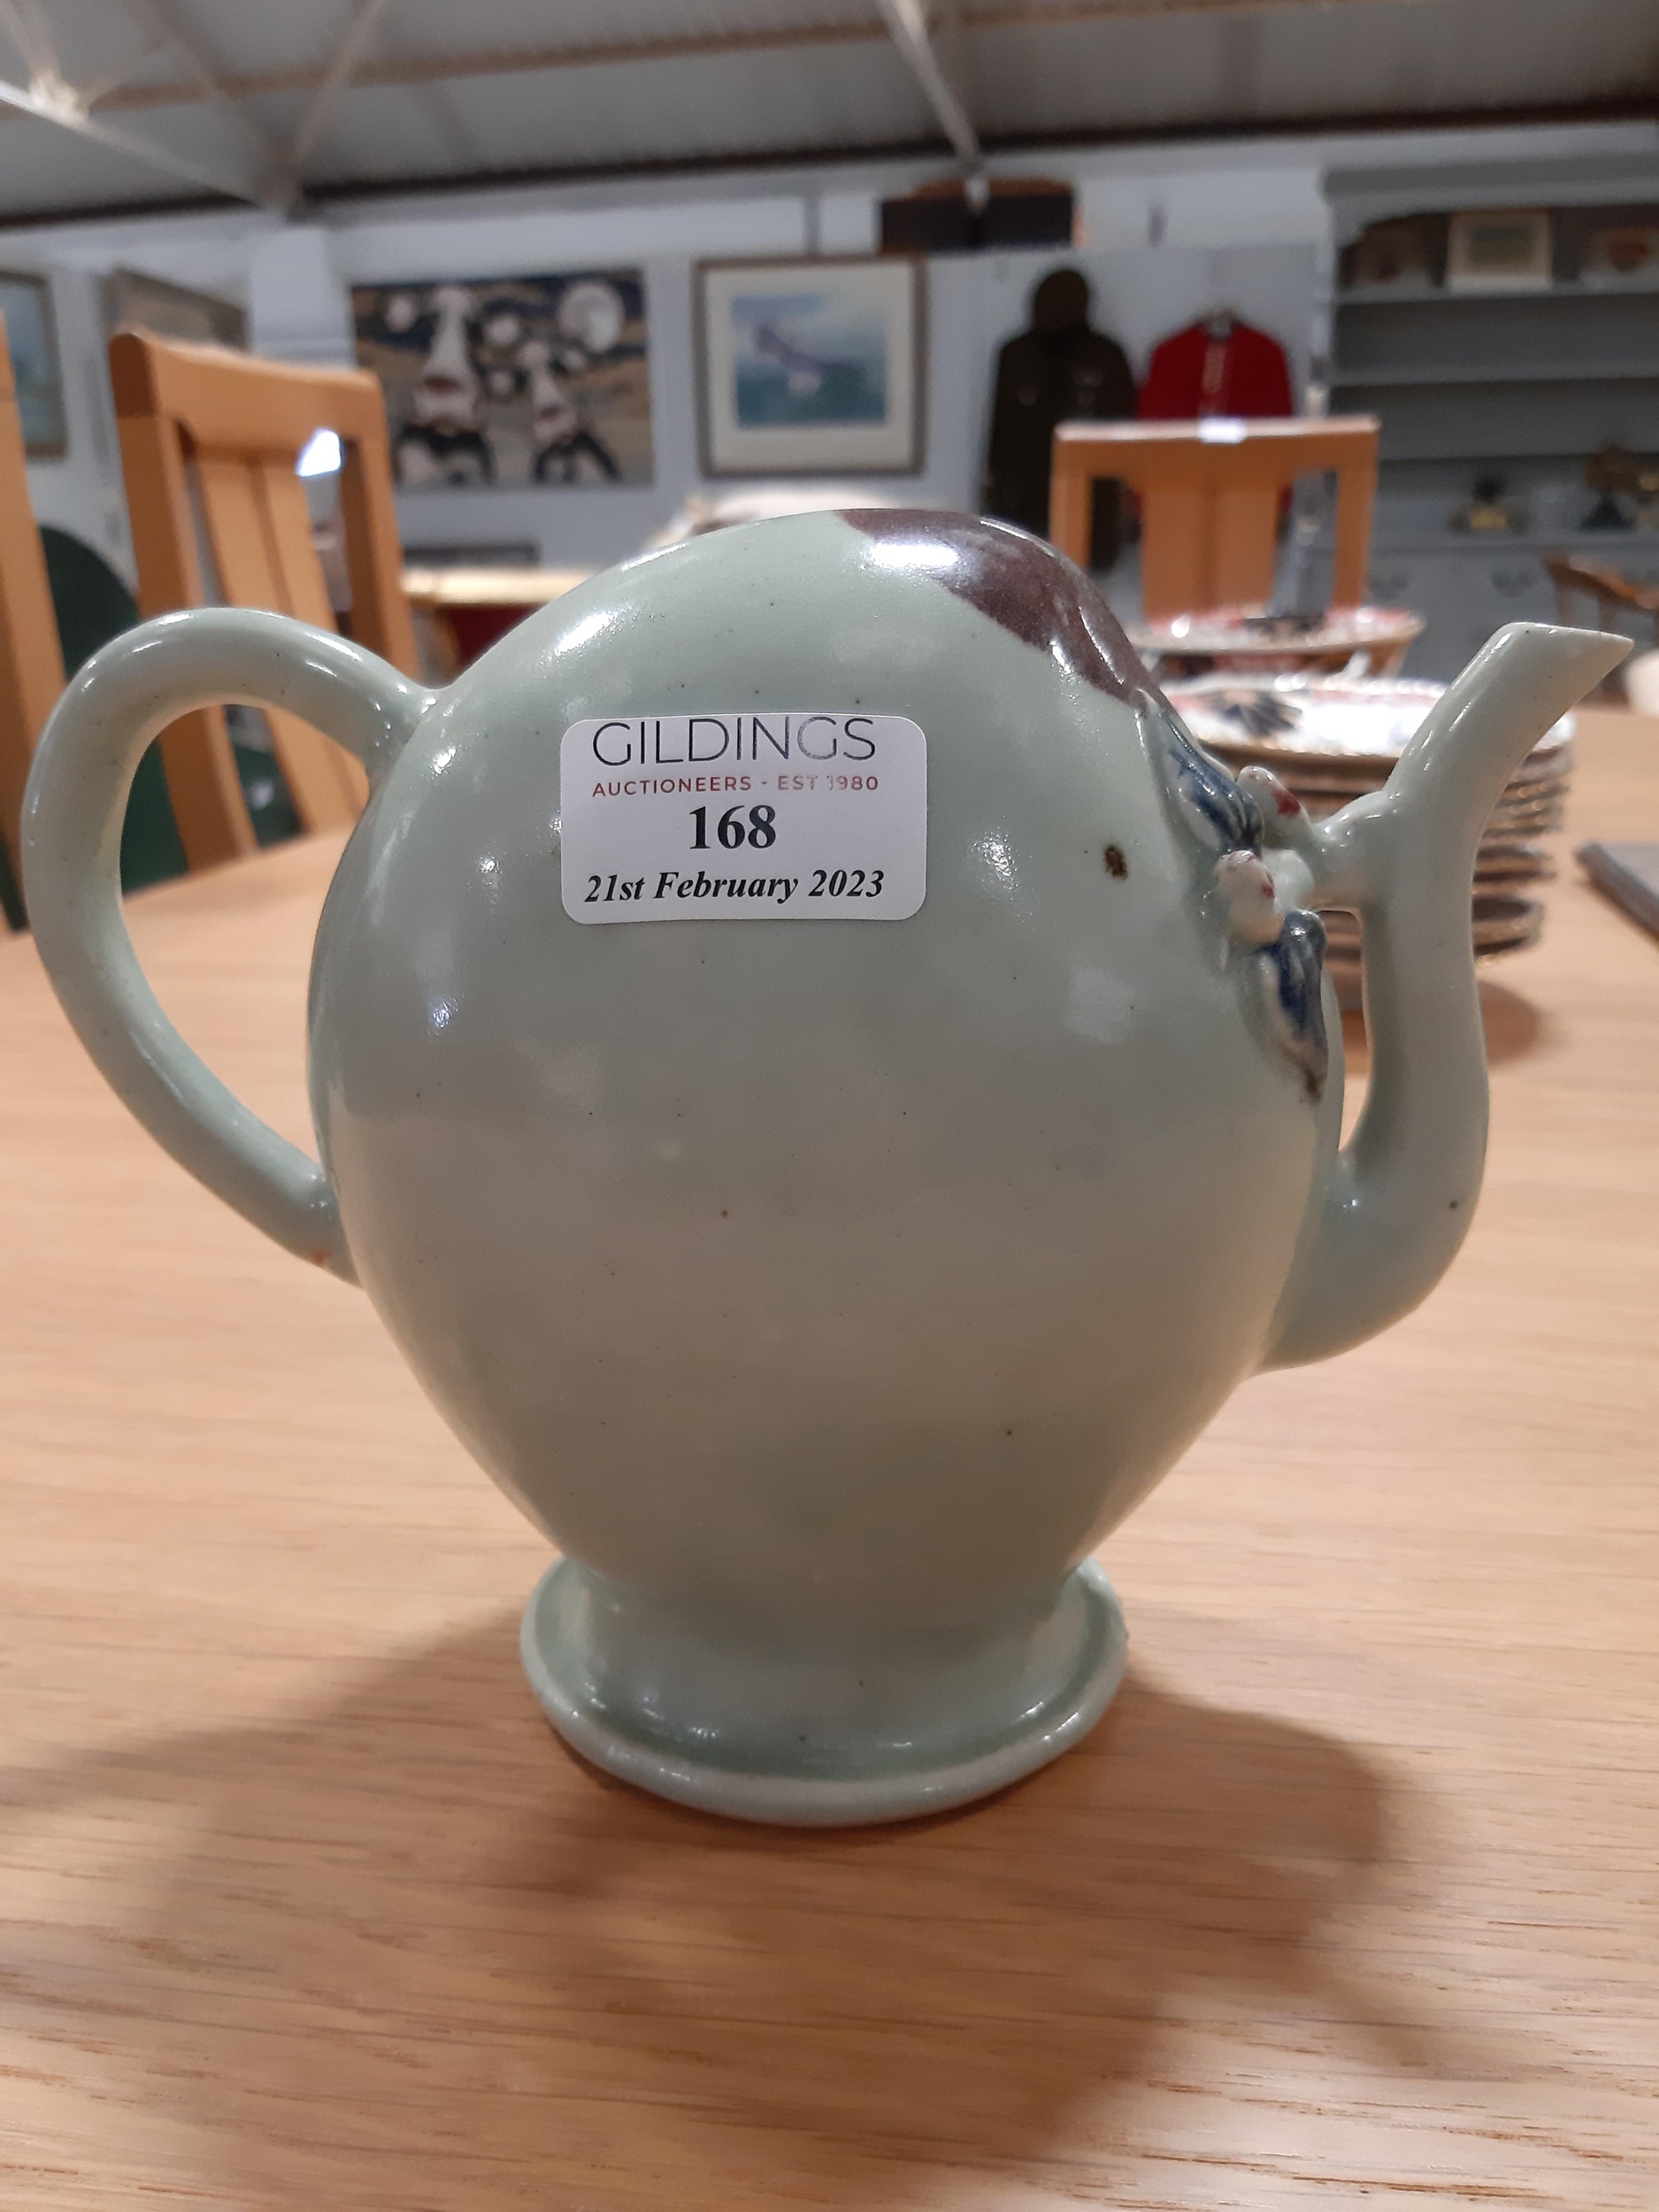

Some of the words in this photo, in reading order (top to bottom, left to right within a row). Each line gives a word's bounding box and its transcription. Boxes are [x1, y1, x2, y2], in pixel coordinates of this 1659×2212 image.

[593, 716, 876, 766] GILDINGS
[592, 775, 752, 797] AUCTIONEERS
[778, 775, 818, 791] EST
[826, 775, 879, 791] 1980
[689, 804, 777, 849] 168
[584, 872, 646, 902] 21st
[653, 871, 798, 903] February
[808, 869, 885, 898] 2023
